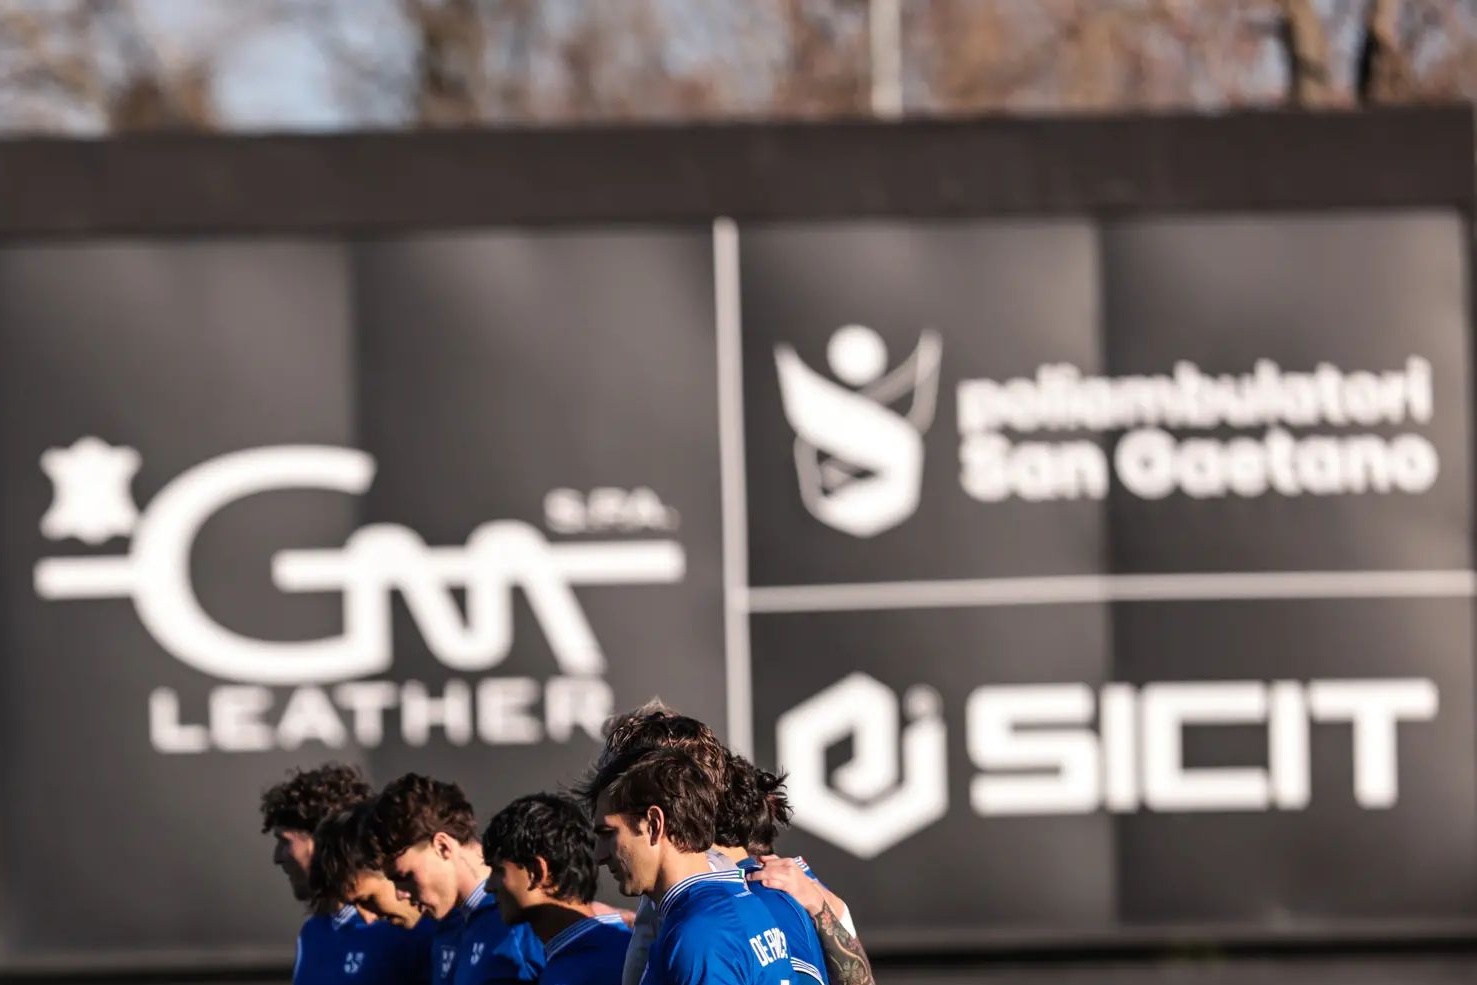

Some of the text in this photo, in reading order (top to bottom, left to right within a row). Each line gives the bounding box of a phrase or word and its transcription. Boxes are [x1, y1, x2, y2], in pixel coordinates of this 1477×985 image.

[958, 424, 1440, 502] San Gaetano
[148, 676, 616, 754] LEATHER
[965, 677, 1439, 817] SICIT
